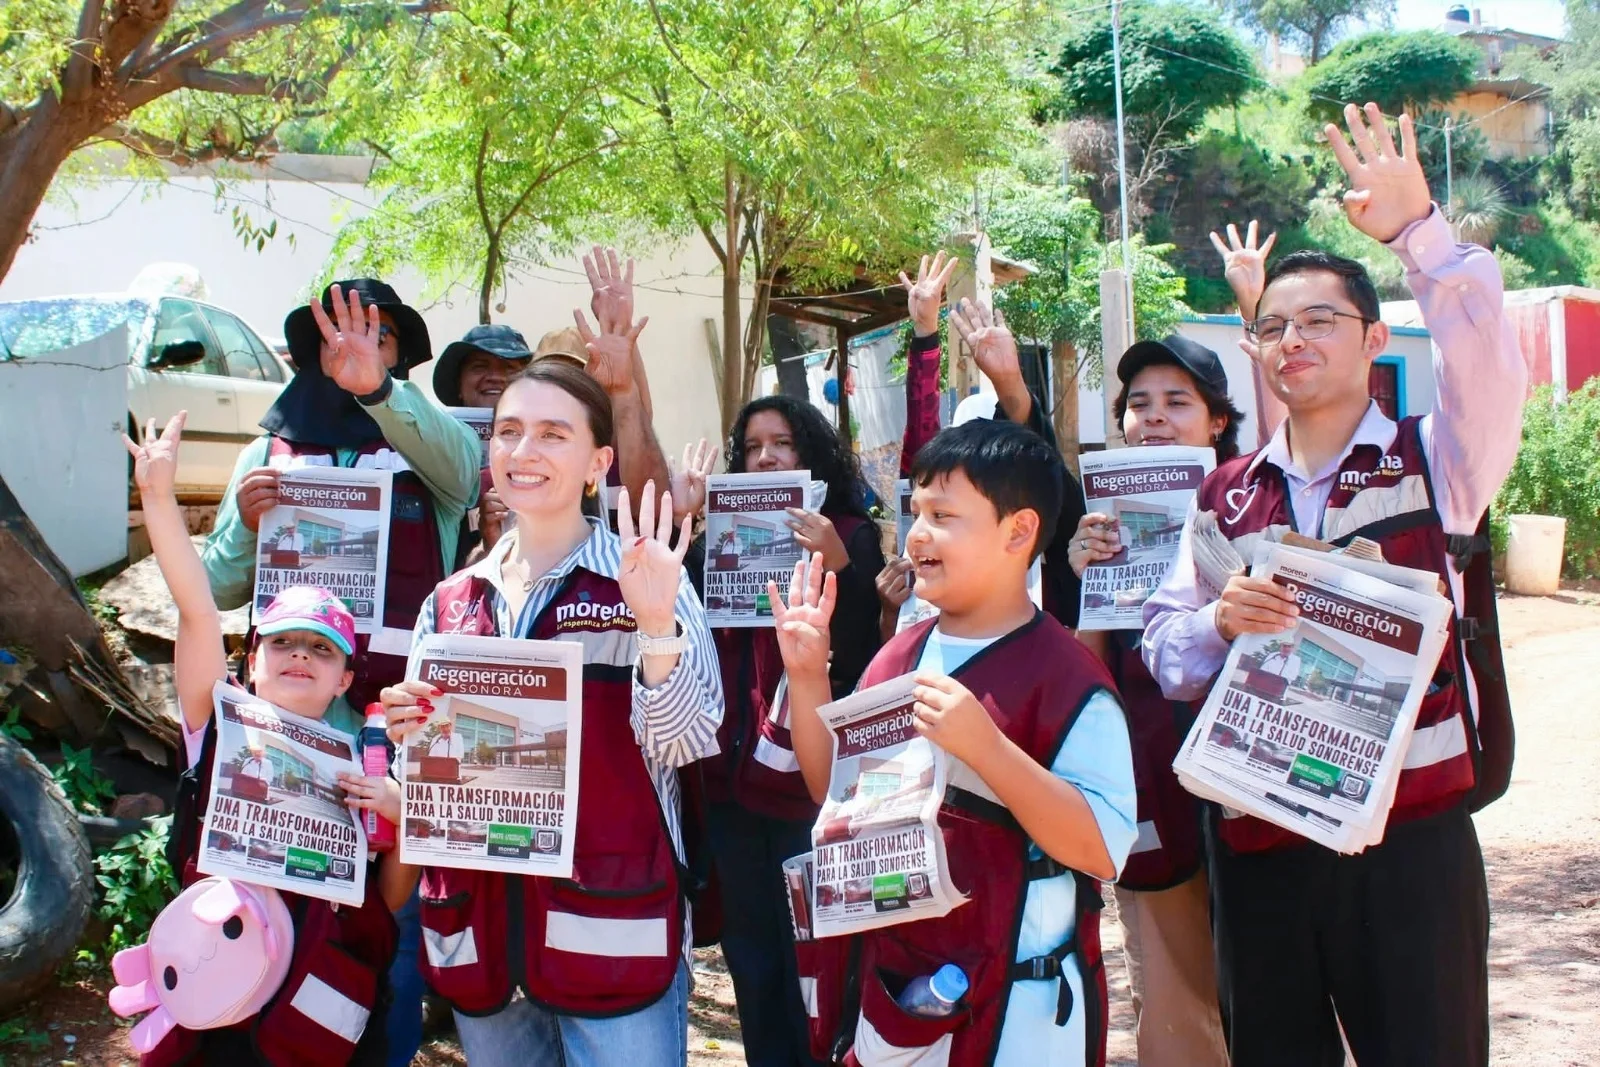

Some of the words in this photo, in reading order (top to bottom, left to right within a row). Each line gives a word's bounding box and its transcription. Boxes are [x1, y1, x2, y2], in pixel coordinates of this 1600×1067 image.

[1092, 468, 1189, 491] Regeneración
[1340, 455, 1404, 485] mona
[278, 484, 367, 501] Regeneración
[717, 490, 792, 508] Regeneración
[1118, 483, 1170, 495] SONORA
[301, 499, 348, 508] SONORA
[737, 504, 777, 512] SONORA
[259, 570, 280, 583] UNA
[284, 571, 376, 588] TRANSFORMACIÓN
[707, 573, 723, 585] UNA
[726, 571, 794, 585] TRANSFORMACI
[1086, 568, 1108, 581] UNA
[1112, 562, 1169, 580] TRANSFOR
[1280, 565, 1308, 578] morena
[258, 584, 280, 594] PARA
[706, 586, 724, 595] PARA
[726, 585, 735, 595] LA
[737, 585, 760, 595] SALUD
[1085, 581, 1107, 593] PARA
[1111, 580, 1121, 592] LA
[1124, 579, 1152, 591] SALUD
[556, 601, 635, 623] morena
[563, 619, 600, 628] esperanza
[1313, 611, 1375, 640] SONORA
[427, 663, 547, 687] Regeneración
[459, 684, 522, 697] SONORA
[266, 723, 317, 747] SONORA
[1222, 689, 1251, 714] UNA
[1256, 700, 1386, 762] TRANSFORMACIÓN
[867, 731, 906, 751] SONORA
[1216, 708, 1246, 729] PARA
[1249, 718, 1265, 737] LA
[1267, 723, 1306, 750] SALUD
[1308, 736, 1380, 778] SONORENSE
[406, 784, 433, 802] UNA
[439, 786, 565, 811] TRANSFORMACIÓN
[214, 796, 239, 818] UNA
[246, 803, 358, 845] TRANSFORMACIÓN
[406, 802, 435, 818] PARA
[439, 804, 453, 819] LA
[457, 805, 493, 822] SALUD
[498, 808, 564, 827] SONORENSE
[210, 814, 238, 833] PARA
[242, 822, 255, 837] LA
[259, 826, 293, 845] SALUD
[296, 833, 357, 859] SONORENSE
[817, 848, 835, 867] UNA
[838, 827, 926, 864] TRANSFORMACIÓN
[816, 866, 837, 884] PARA
[838, 864, 848, 880] LA
[851, 860, 876, 879] SALUD
[878, 850, 927, 876] SONORENSE
